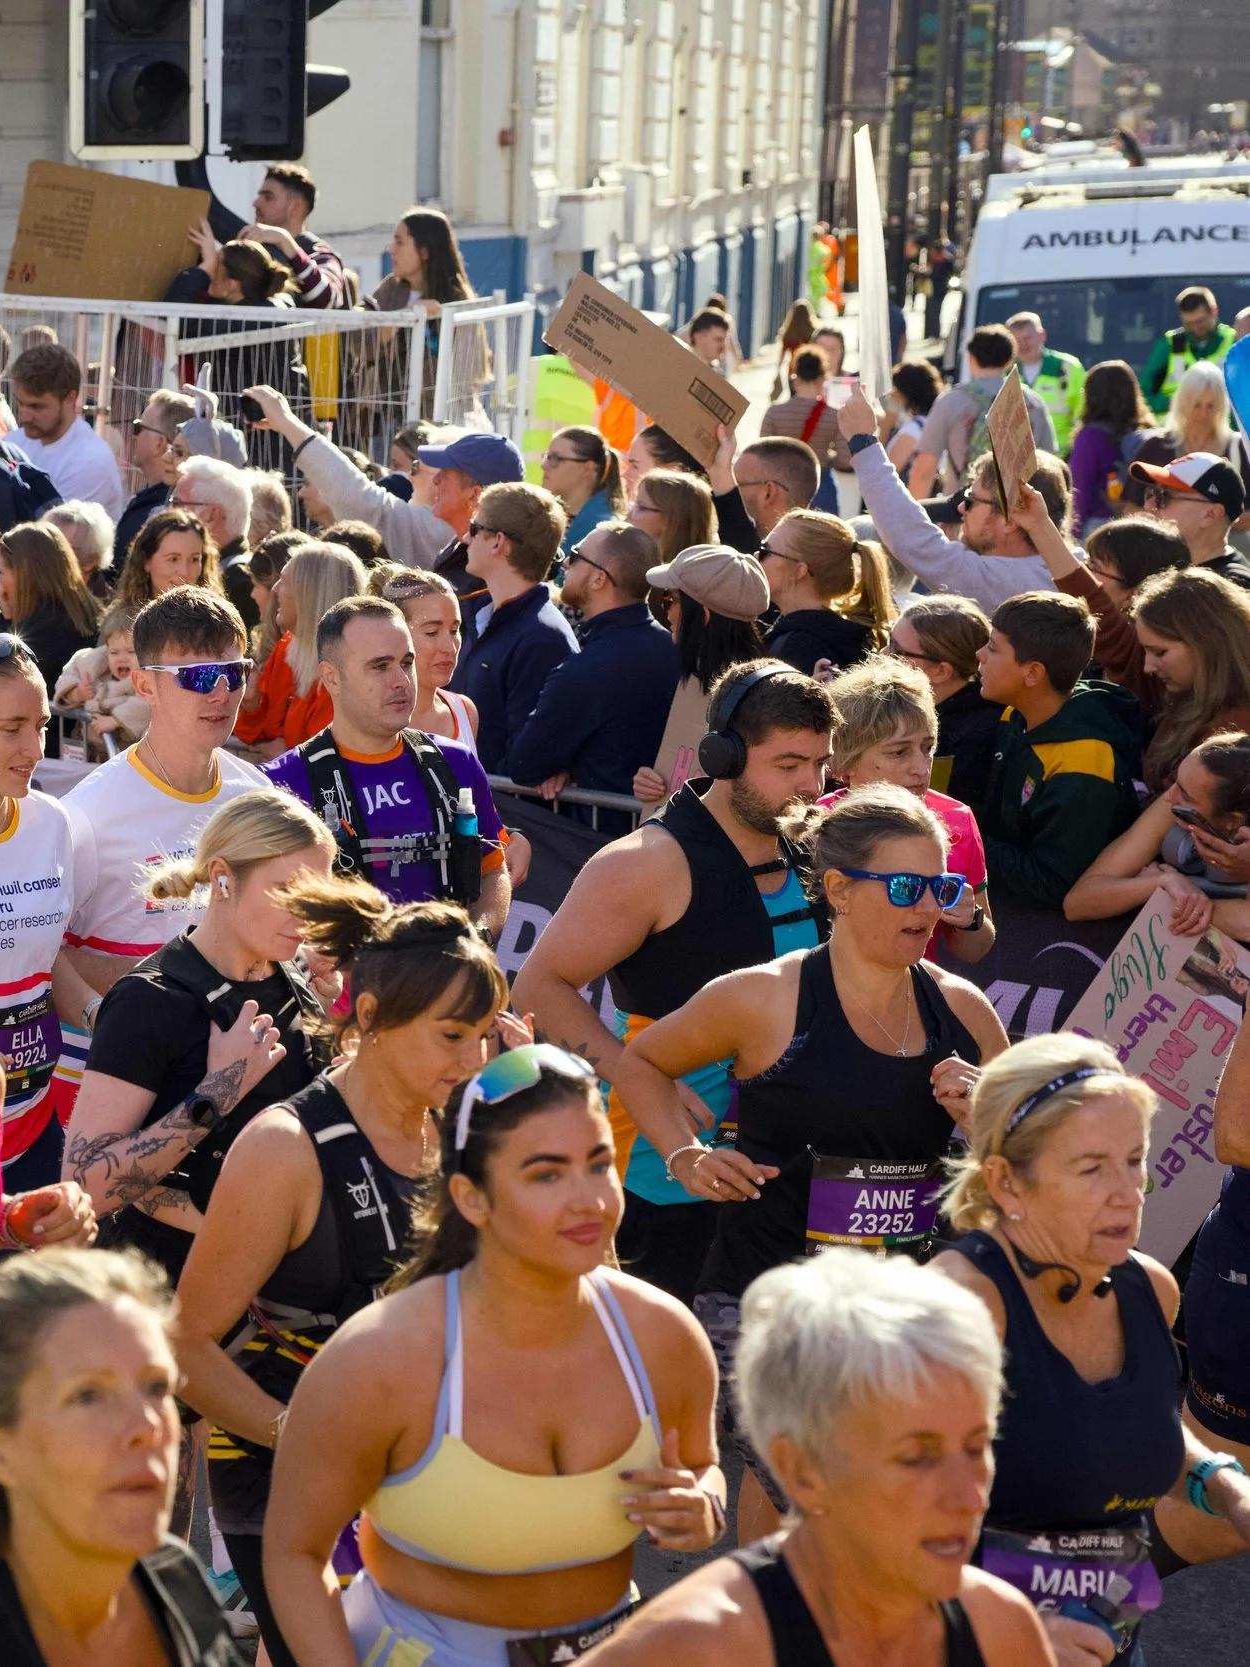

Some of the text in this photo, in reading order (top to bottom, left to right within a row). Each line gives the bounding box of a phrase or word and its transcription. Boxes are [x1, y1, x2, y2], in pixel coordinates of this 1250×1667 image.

[1022, 225, 1249, 251] AMBULANCE
[362, 781, 412, 816] JAC
[23, 877, 62, 893] canser
[20, 910, 64, 929] research
[1104, 912, 1170, 1030] Hugo
[11, 1024, 44, 1050] ELLA
[869, 1163, 928, 1174] CARDIFF HALF
[854, 1189, 916, 1210] ANNE
[848, 1212, 914, 1234] 23252
[1100, 1535, 1125, 1549] HALF
